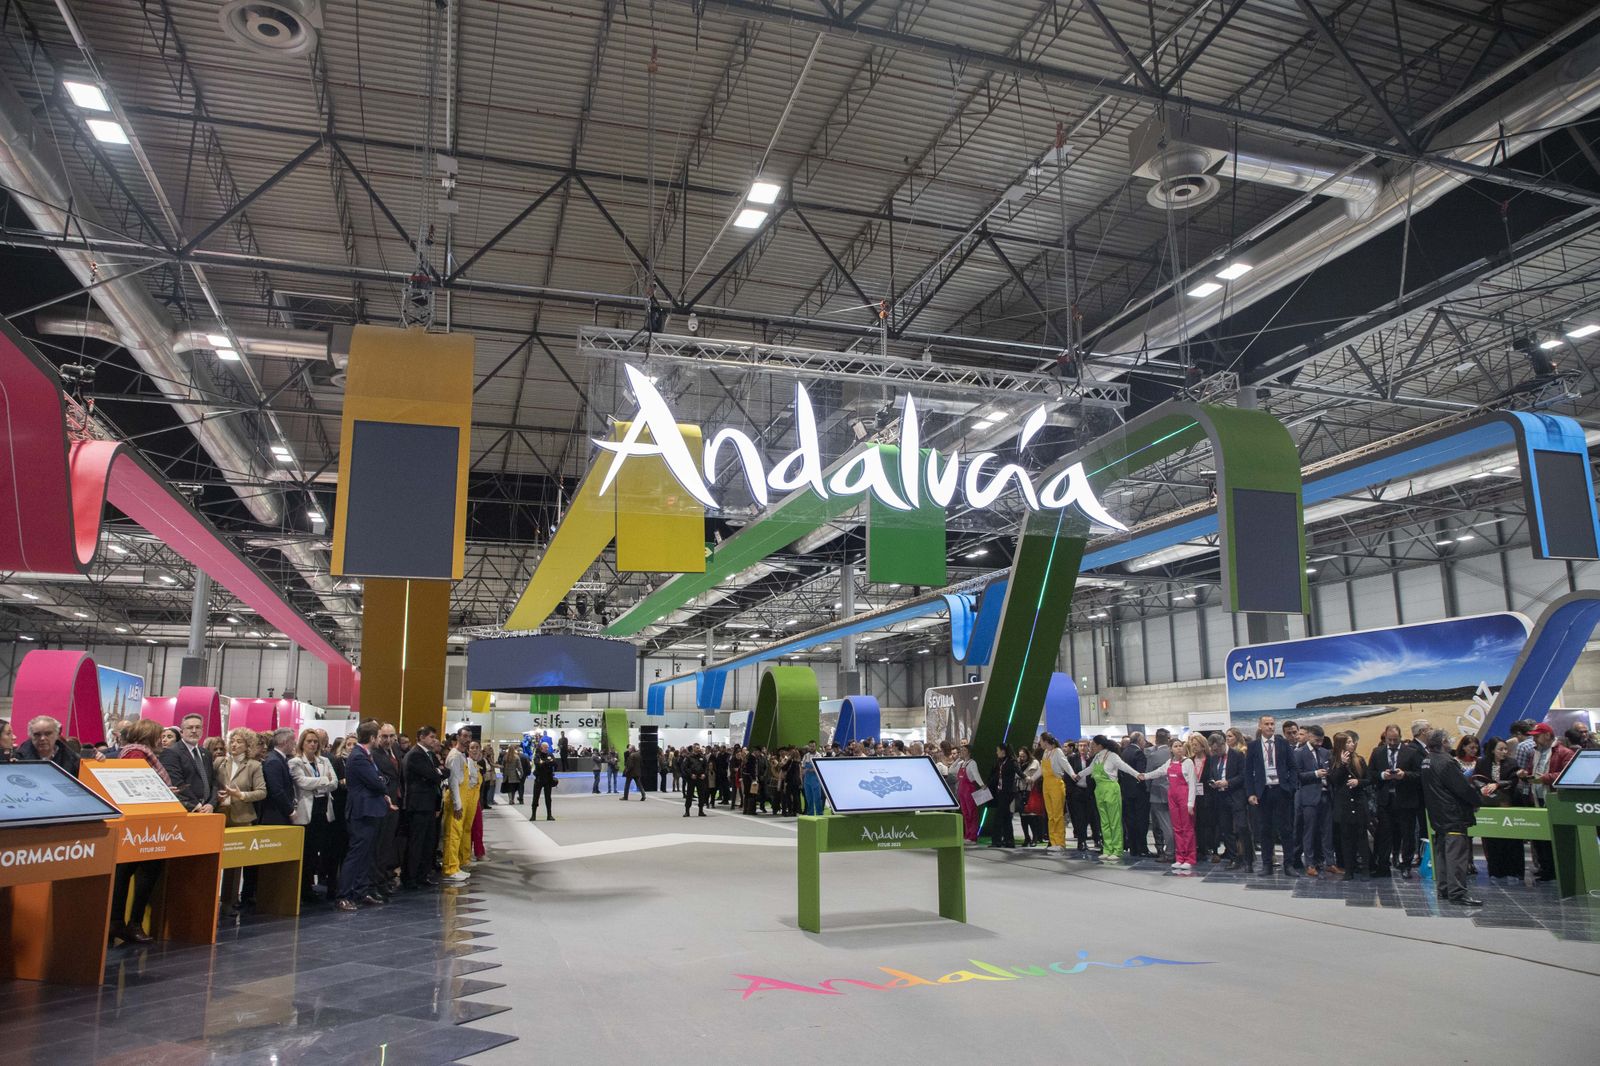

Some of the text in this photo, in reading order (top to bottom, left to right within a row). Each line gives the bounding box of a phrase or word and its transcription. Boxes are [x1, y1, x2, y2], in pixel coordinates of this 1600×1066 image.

[591, 363, 1128, 531] Andalucía
[1232, 656, 1285, 681] CÁDIZ
[928, 694, 955, 708] SEVILLA
[122, 824, 186, 846] Andalucía
[861, 825, 918, 841] Andalucía
[0, 840, 95, 867] ORMACIÓN
